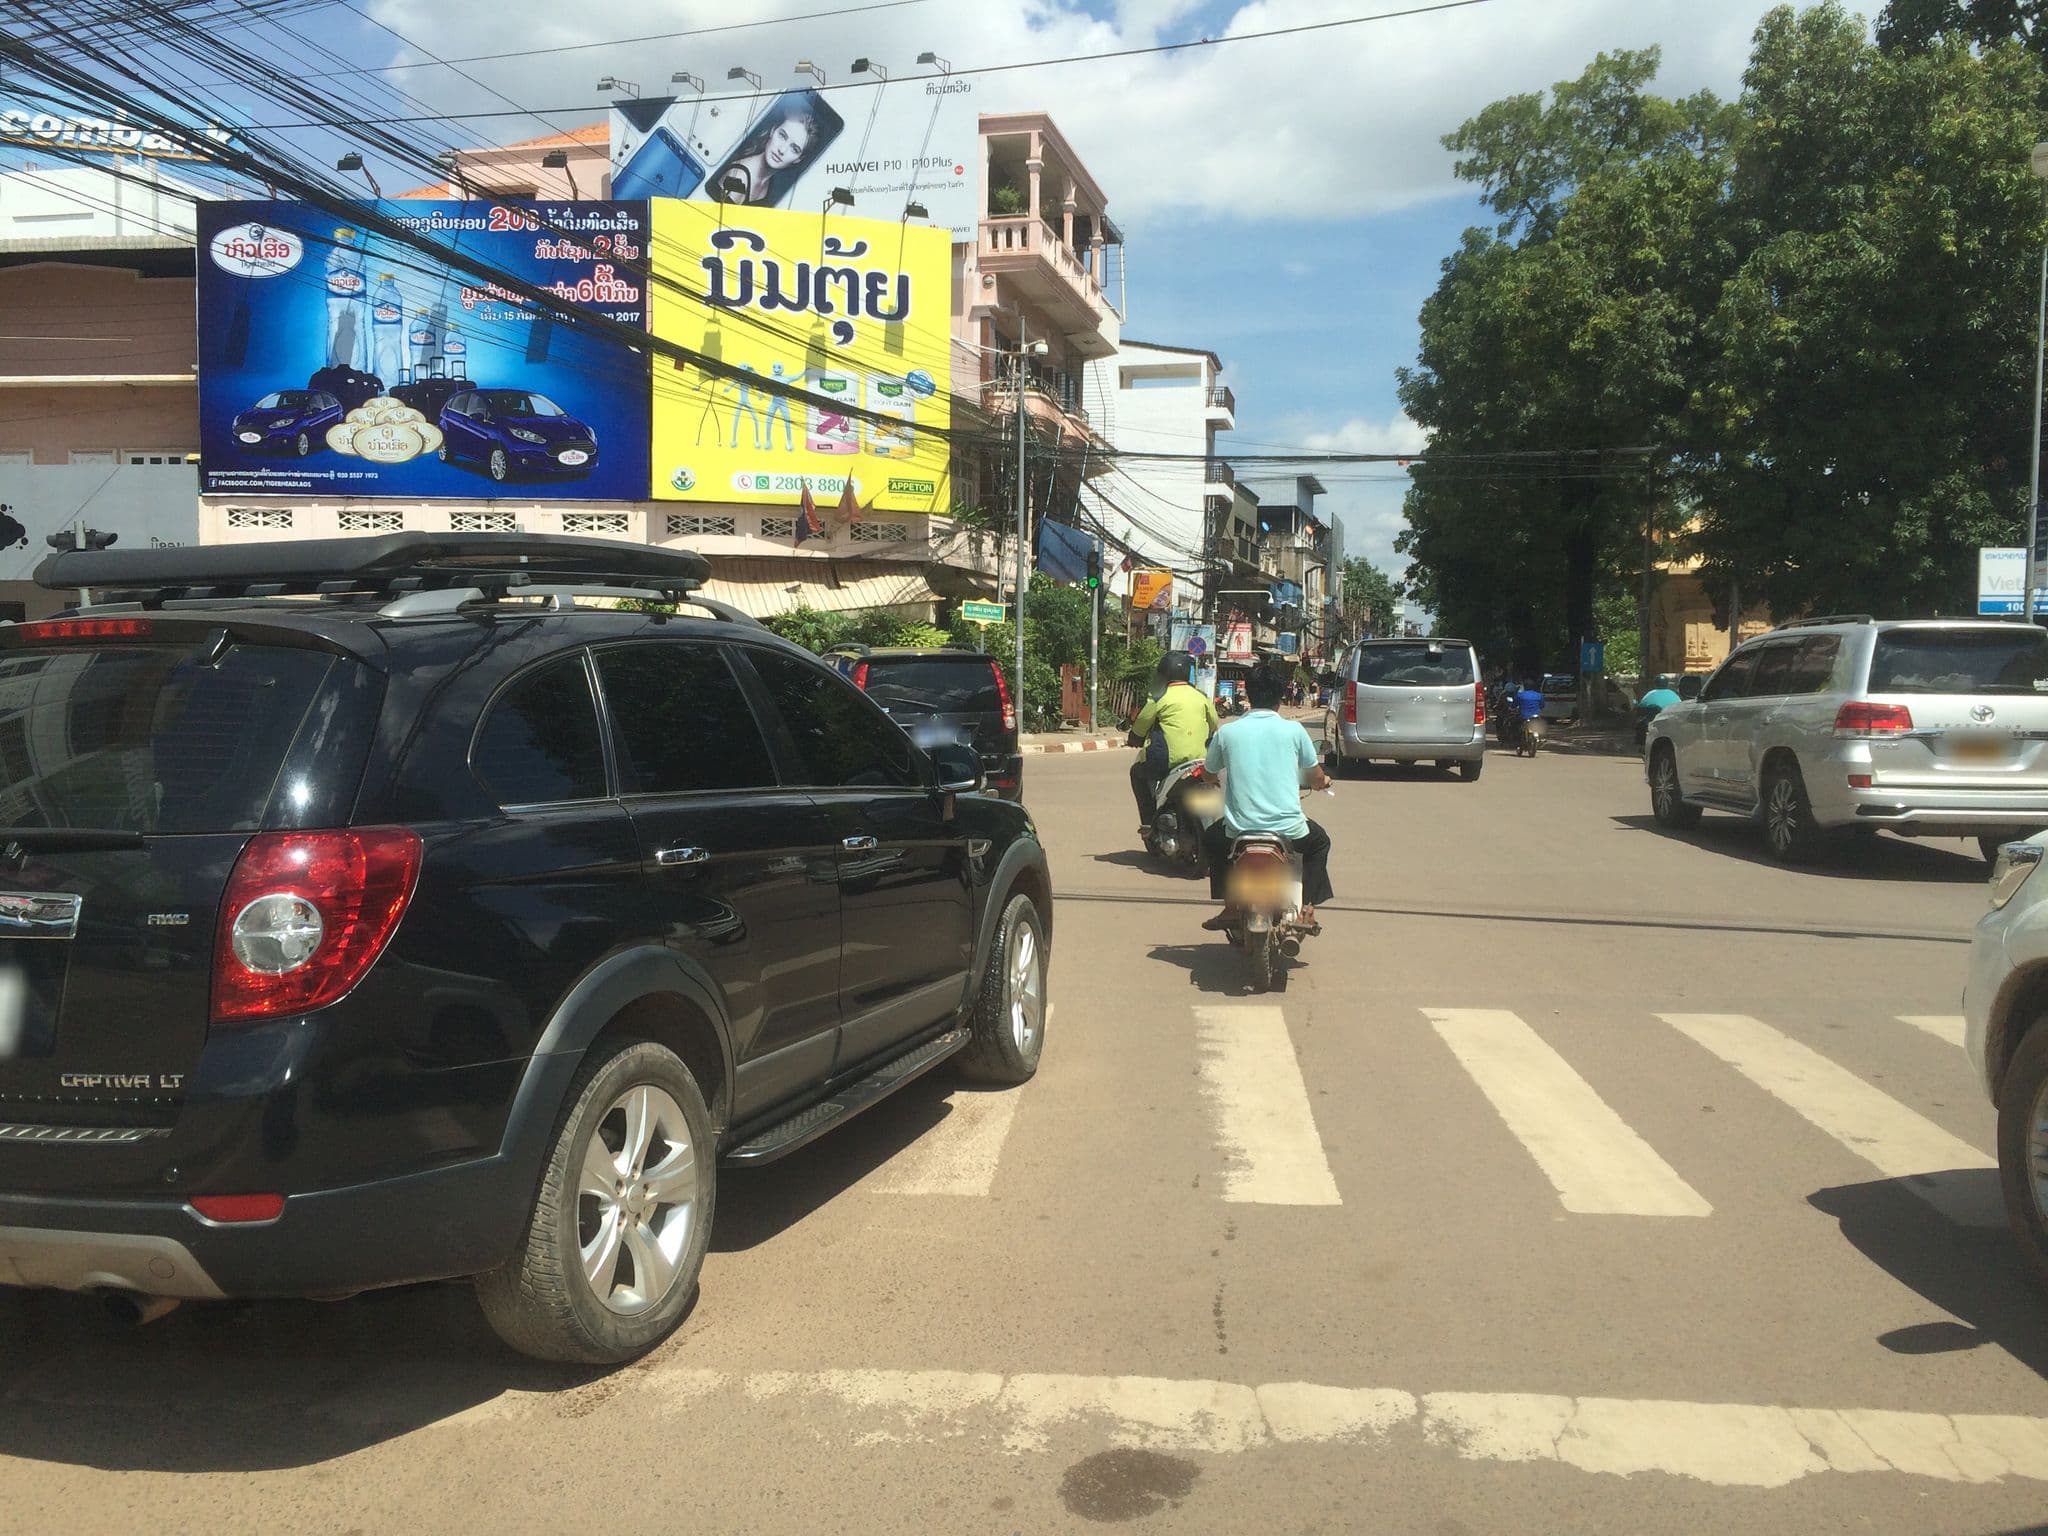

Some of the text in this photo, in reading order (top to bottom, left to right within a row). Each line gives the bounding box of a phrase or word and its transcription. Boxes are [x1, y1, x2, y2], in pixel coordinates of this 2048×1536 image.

[826, 155, 953, 174] HUAWEI P10 P10 Plus
[616, 312, 640, 321] 2017
[775, 476, 813, 490] 2803
[891, 481, 933, 493] APPETON
[61, 1073, 184, 1089] CAPTIVA LT
